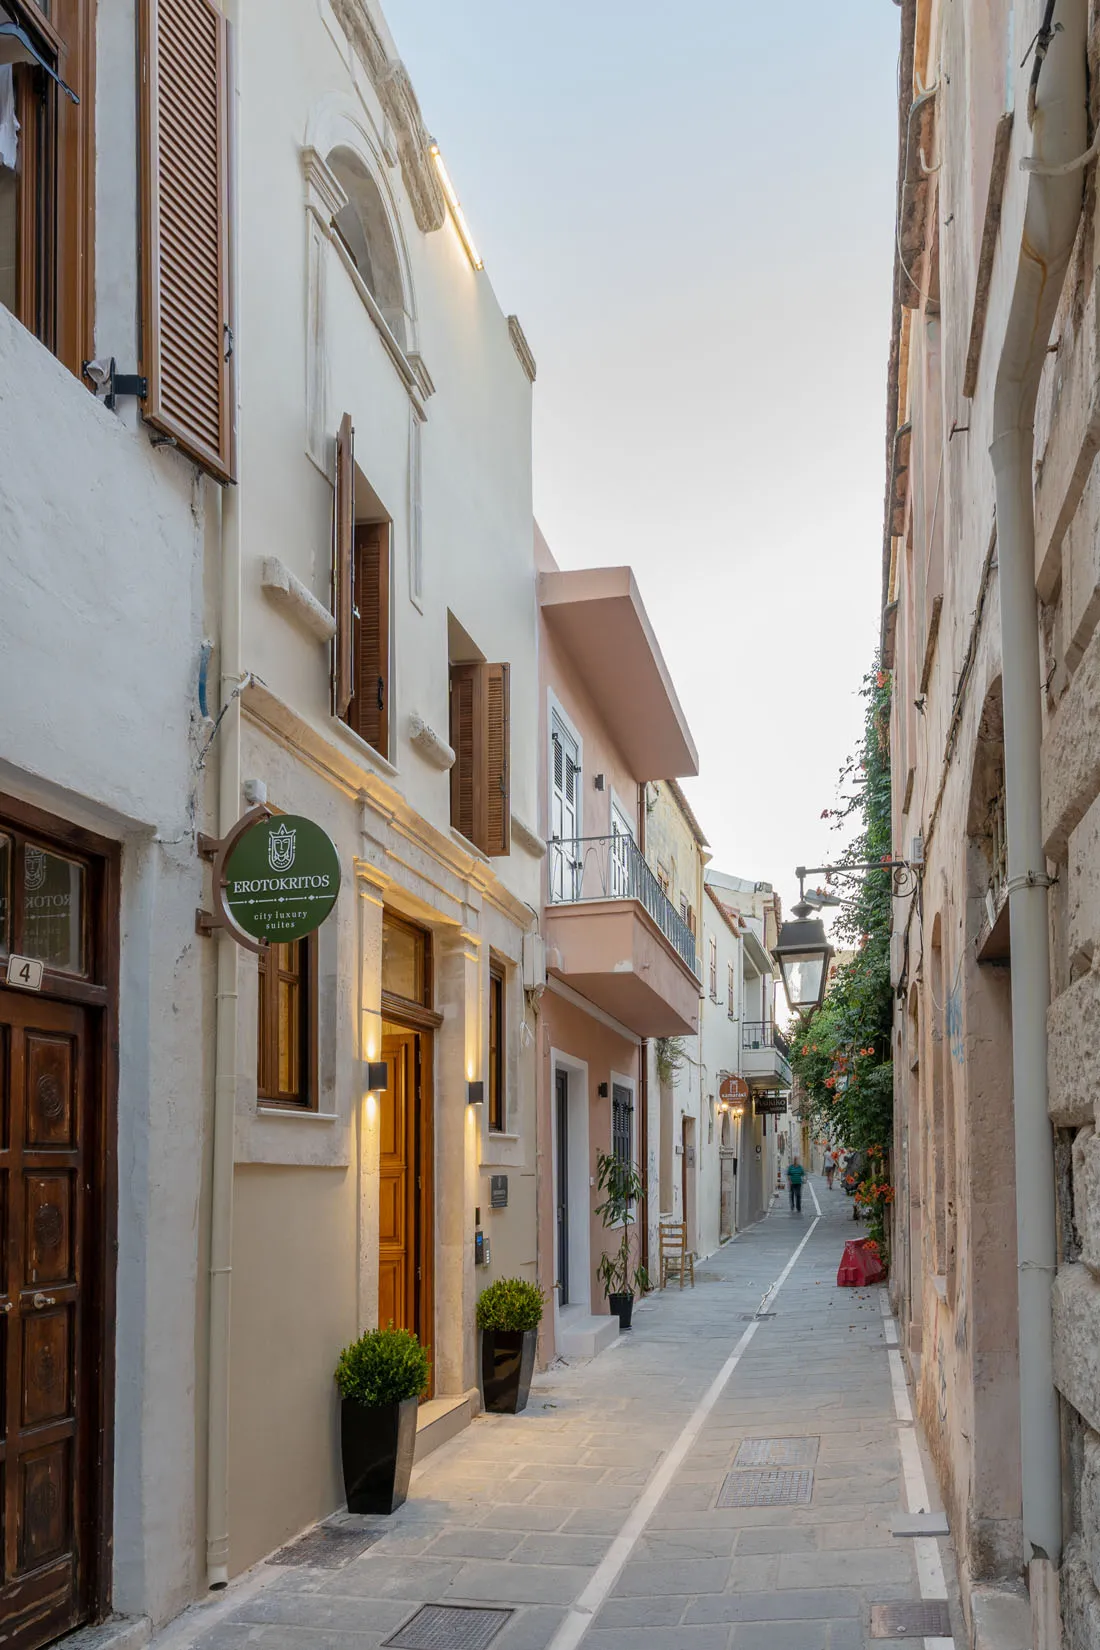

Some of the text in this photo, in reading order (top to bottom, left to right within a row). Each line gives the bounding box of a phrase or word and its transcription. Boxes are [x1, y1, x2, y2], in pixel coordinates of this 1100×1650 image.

[233, 875, 330, 893] EROTOKRITOS
[254, 910, 308, 921] city luxury
[266, 920, 295, 929] suites
[19, 963, 30, 982] 4
